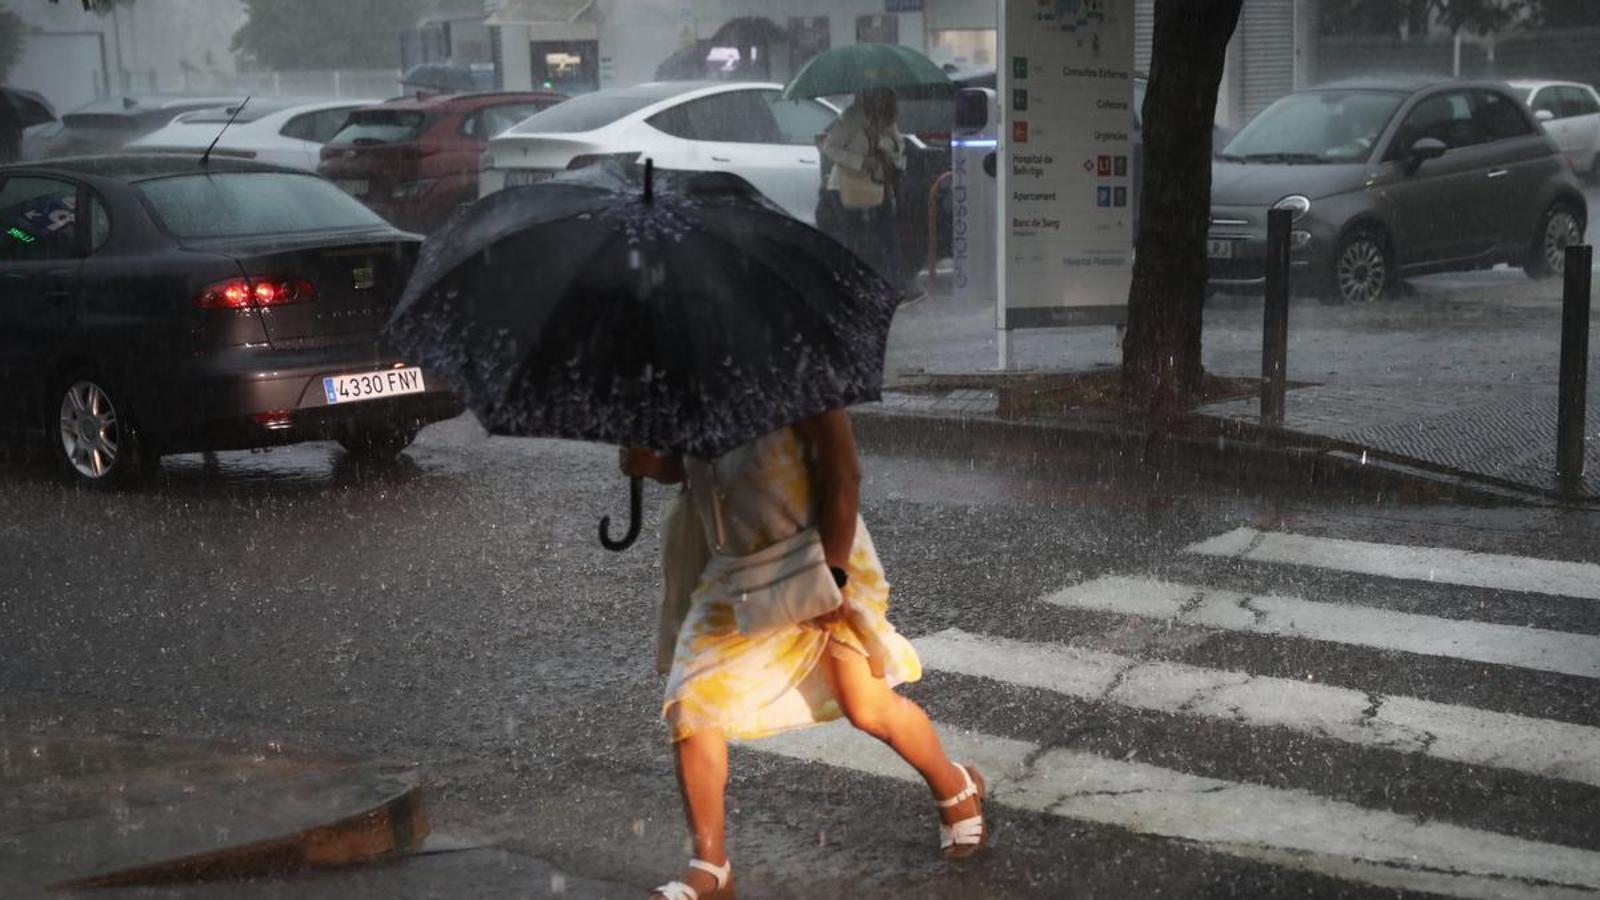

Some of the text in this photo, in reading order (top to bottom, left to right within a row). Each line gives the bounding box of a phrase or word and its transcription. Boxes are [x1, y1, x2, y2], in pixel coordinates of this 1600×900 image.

[1013, 153, 1042, 165] Hospital
[339, 371, 419, 398] 4330 FNY
